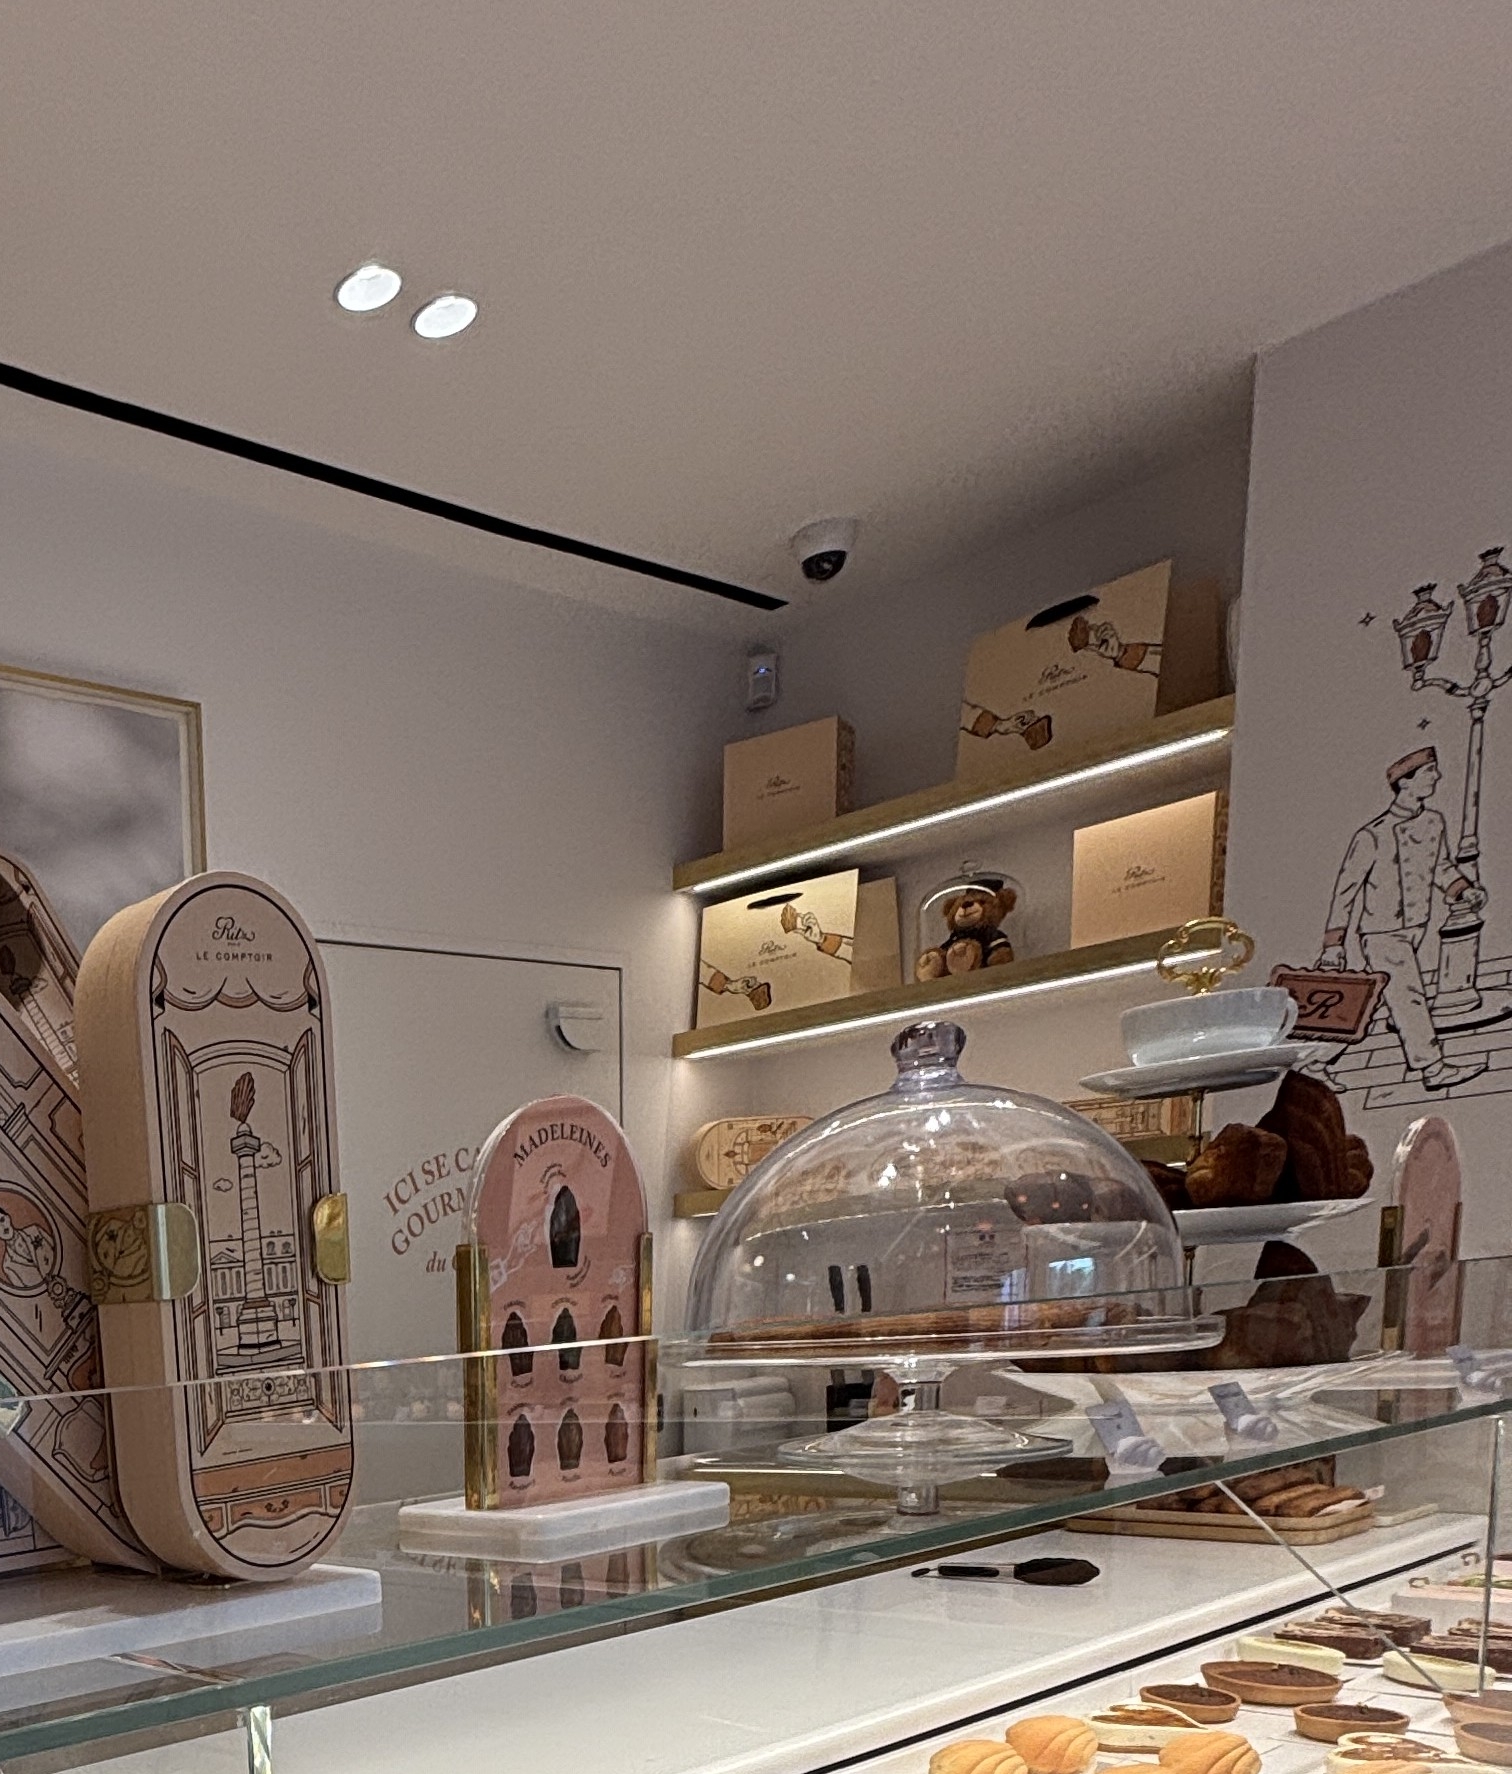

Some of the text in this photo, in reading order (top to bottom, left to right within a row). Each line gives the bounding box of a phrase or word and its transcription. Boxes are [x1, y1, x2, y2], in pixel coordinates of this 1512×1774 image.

[211, 916, 256, 942] Ritz
[196, 951, 273, 961] LE COMPTOIR
[512, 1122, 612, 1169] MADELEINES
[383, 1168, 422, 1217] ICI
[421, 1153, 451, 1186] SE
[425, 1251, 447, 1273] du
